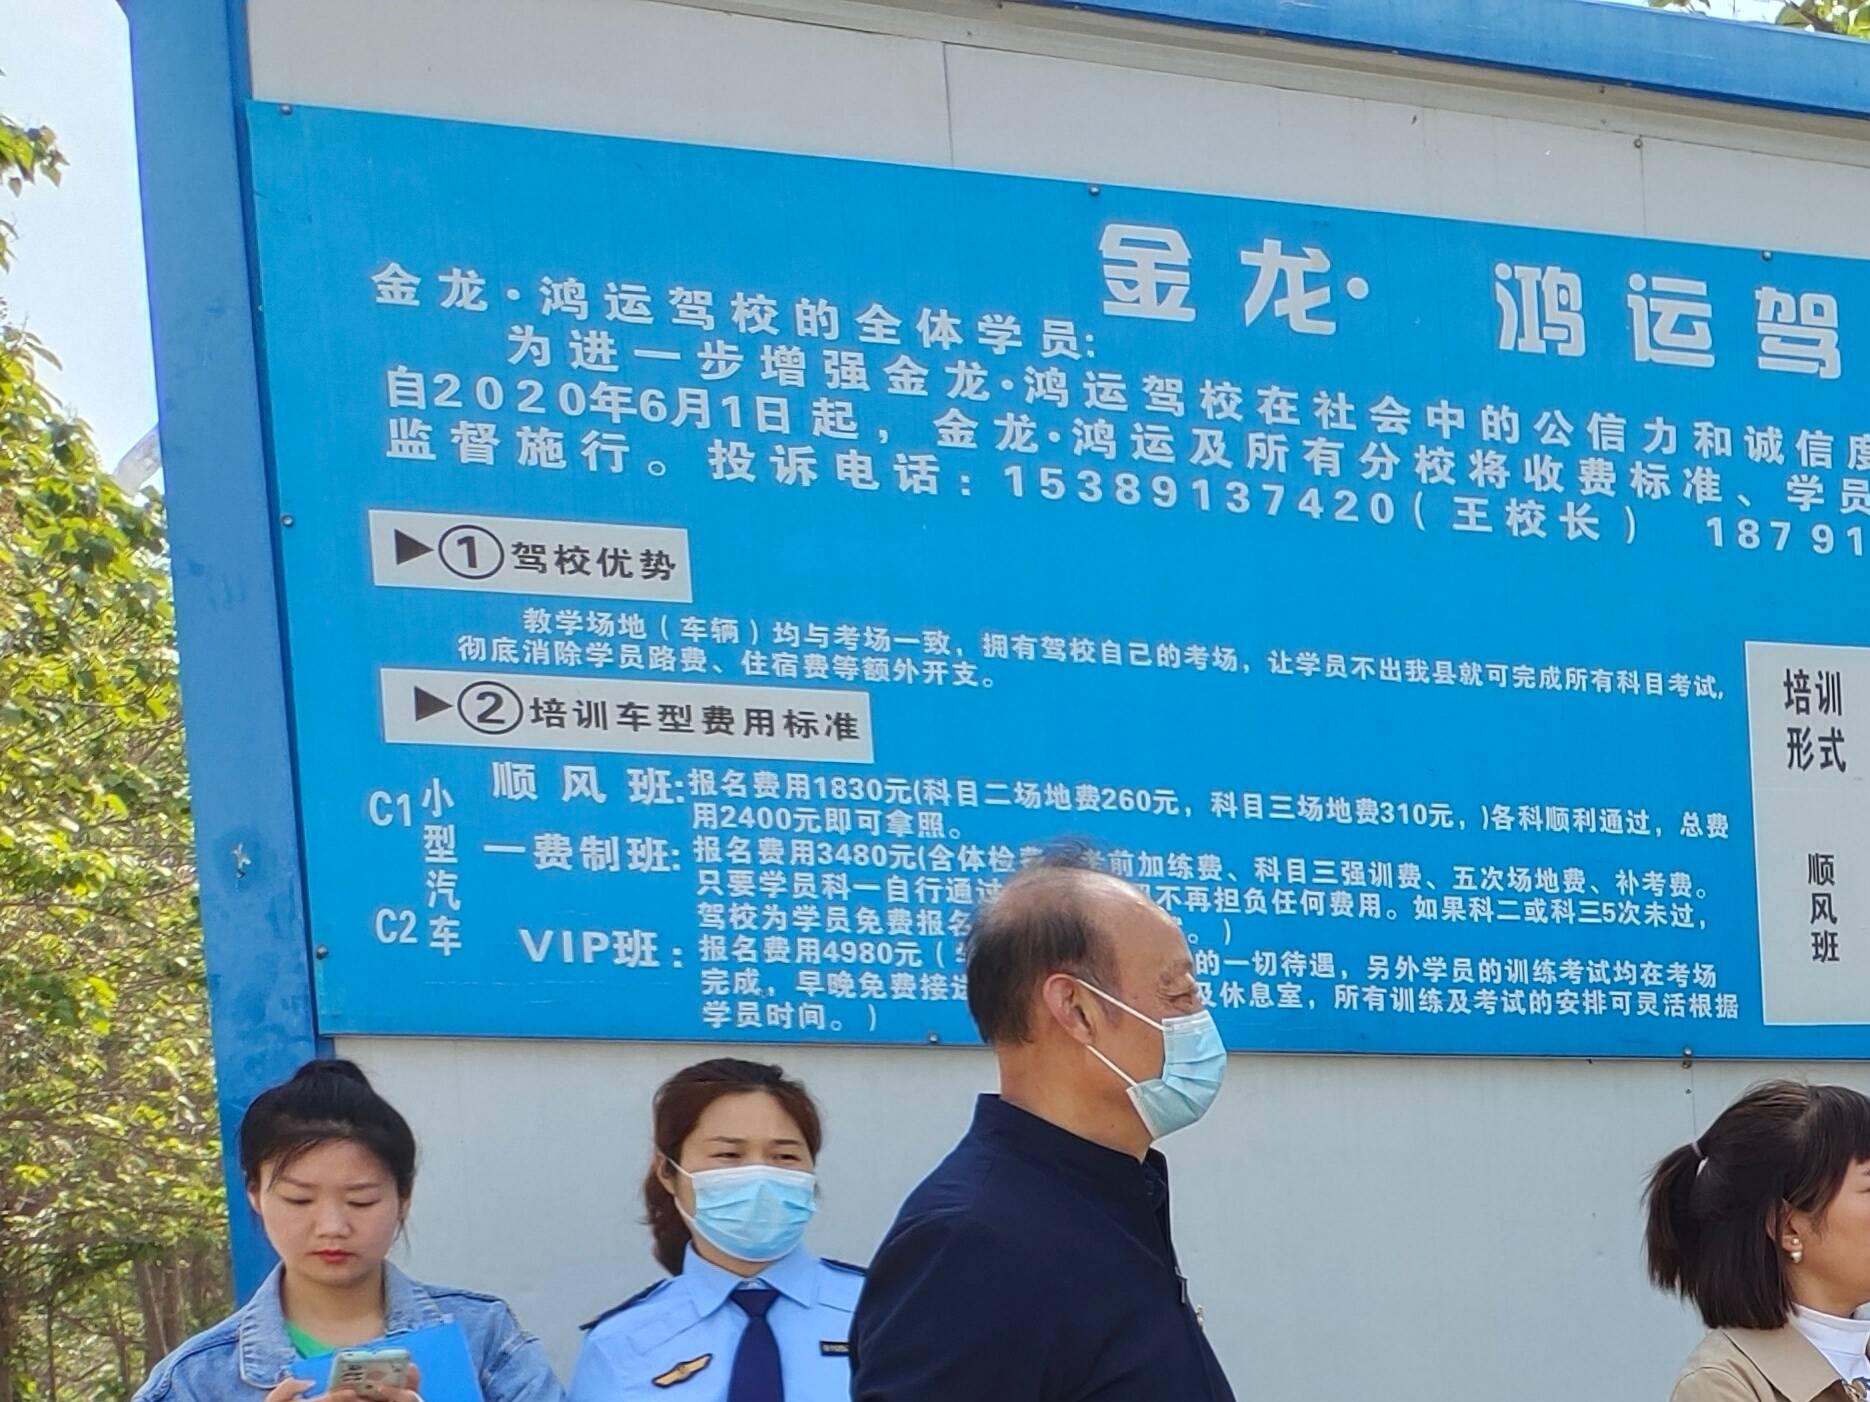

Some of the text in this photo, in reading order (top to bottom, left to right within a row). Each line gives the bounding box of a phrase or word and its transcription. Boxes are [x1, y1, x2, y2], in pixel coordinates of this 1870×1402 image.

[458, 635, 995, 689] 彻底消除学员路费、住宿费等额外开支。
[1783, 668, 1842, 716] 培训
[1786, 726, 1847, 773] 形式
[369, 790, 411, 826] C1
[693, 802, 961, 839] 用2400元即可拿照。
[422, 778, 461, 956] 小型汽车
[375, 908, 417, 943] C2
[1807, 852, 1840, 963] 顺风班
